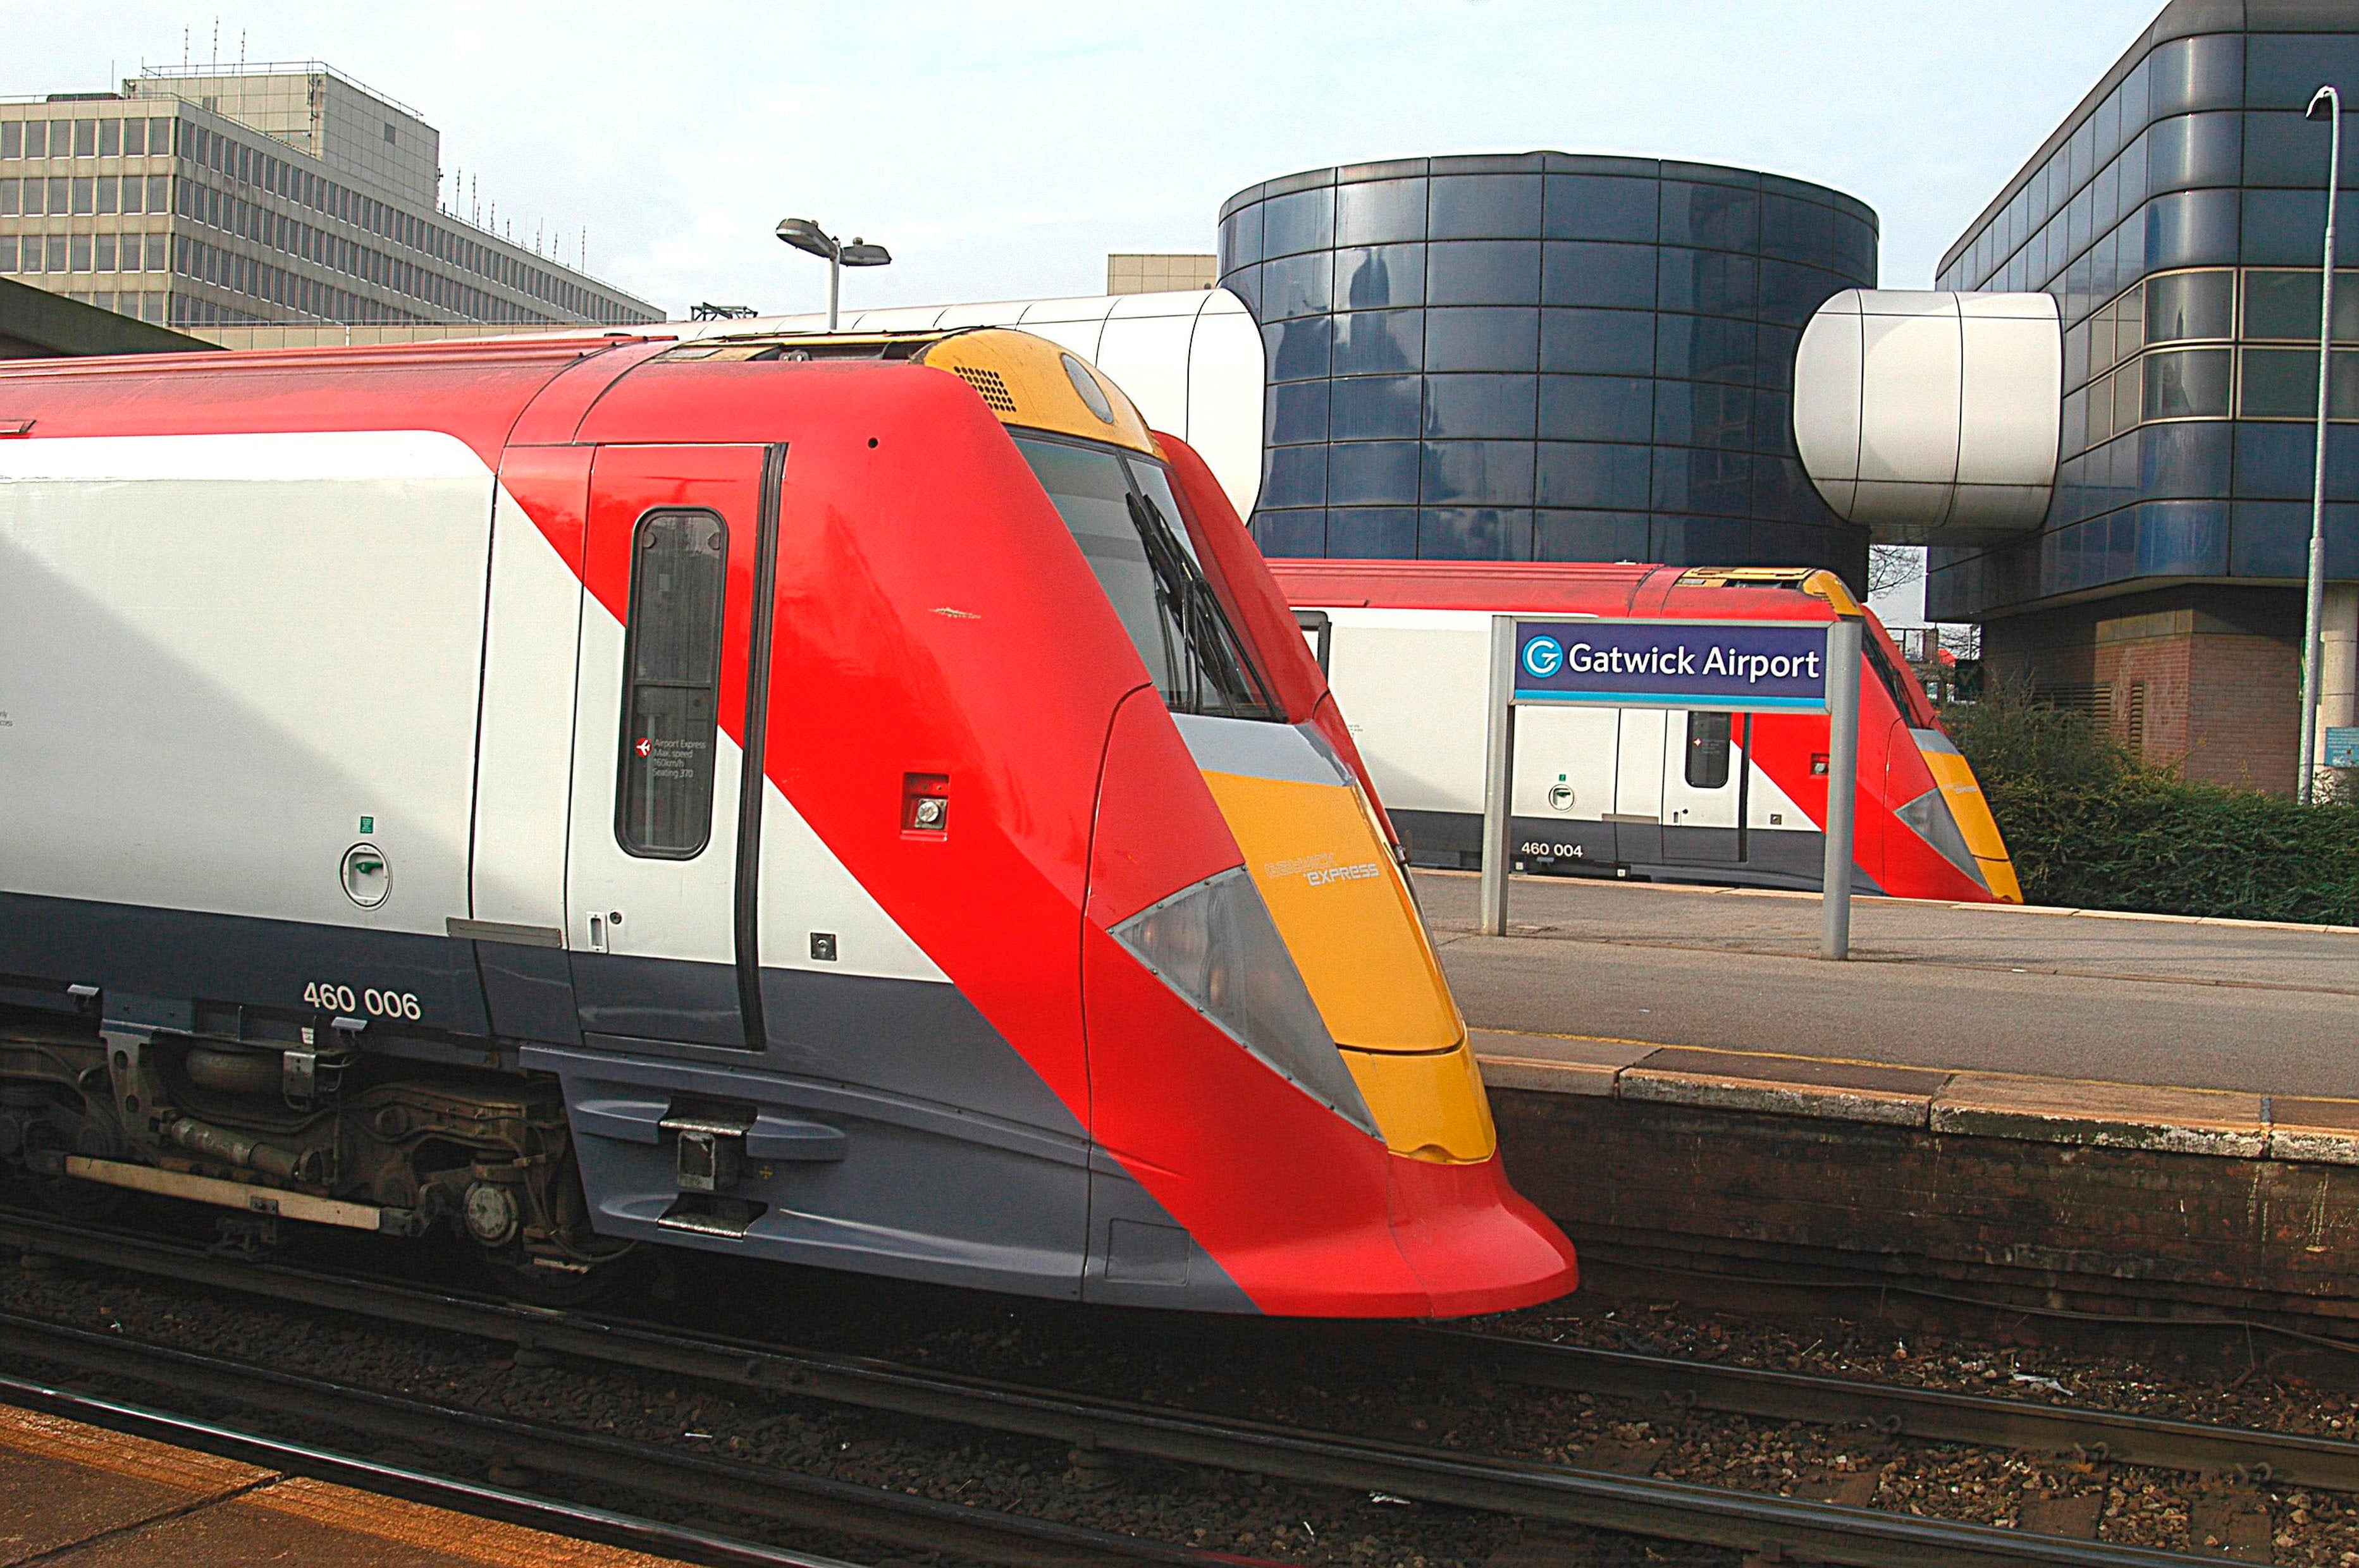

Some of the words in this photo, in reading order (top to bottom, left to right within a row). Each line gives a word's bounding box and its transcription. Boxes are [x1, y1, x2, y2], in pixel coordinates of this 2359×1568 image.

[1569, 644, 1696, 675] Gatwick
[1702, 646, 1820, 683] Airport
[654, 738, 679, 749] Airport
[680, 740, 706, 749] Express
[672, 750, 693, 759] speed
[653, 758, 684, 767] 160km/h
[653, 768, 679, 779] Seating
[679, 768, 694, 778] 370
[1521, 842, 1549, 855] 460
[1554, 843, 1583, 858] 004
[304, 981, 356, 1013] 460
[364, 988, 421, 1020] 006
